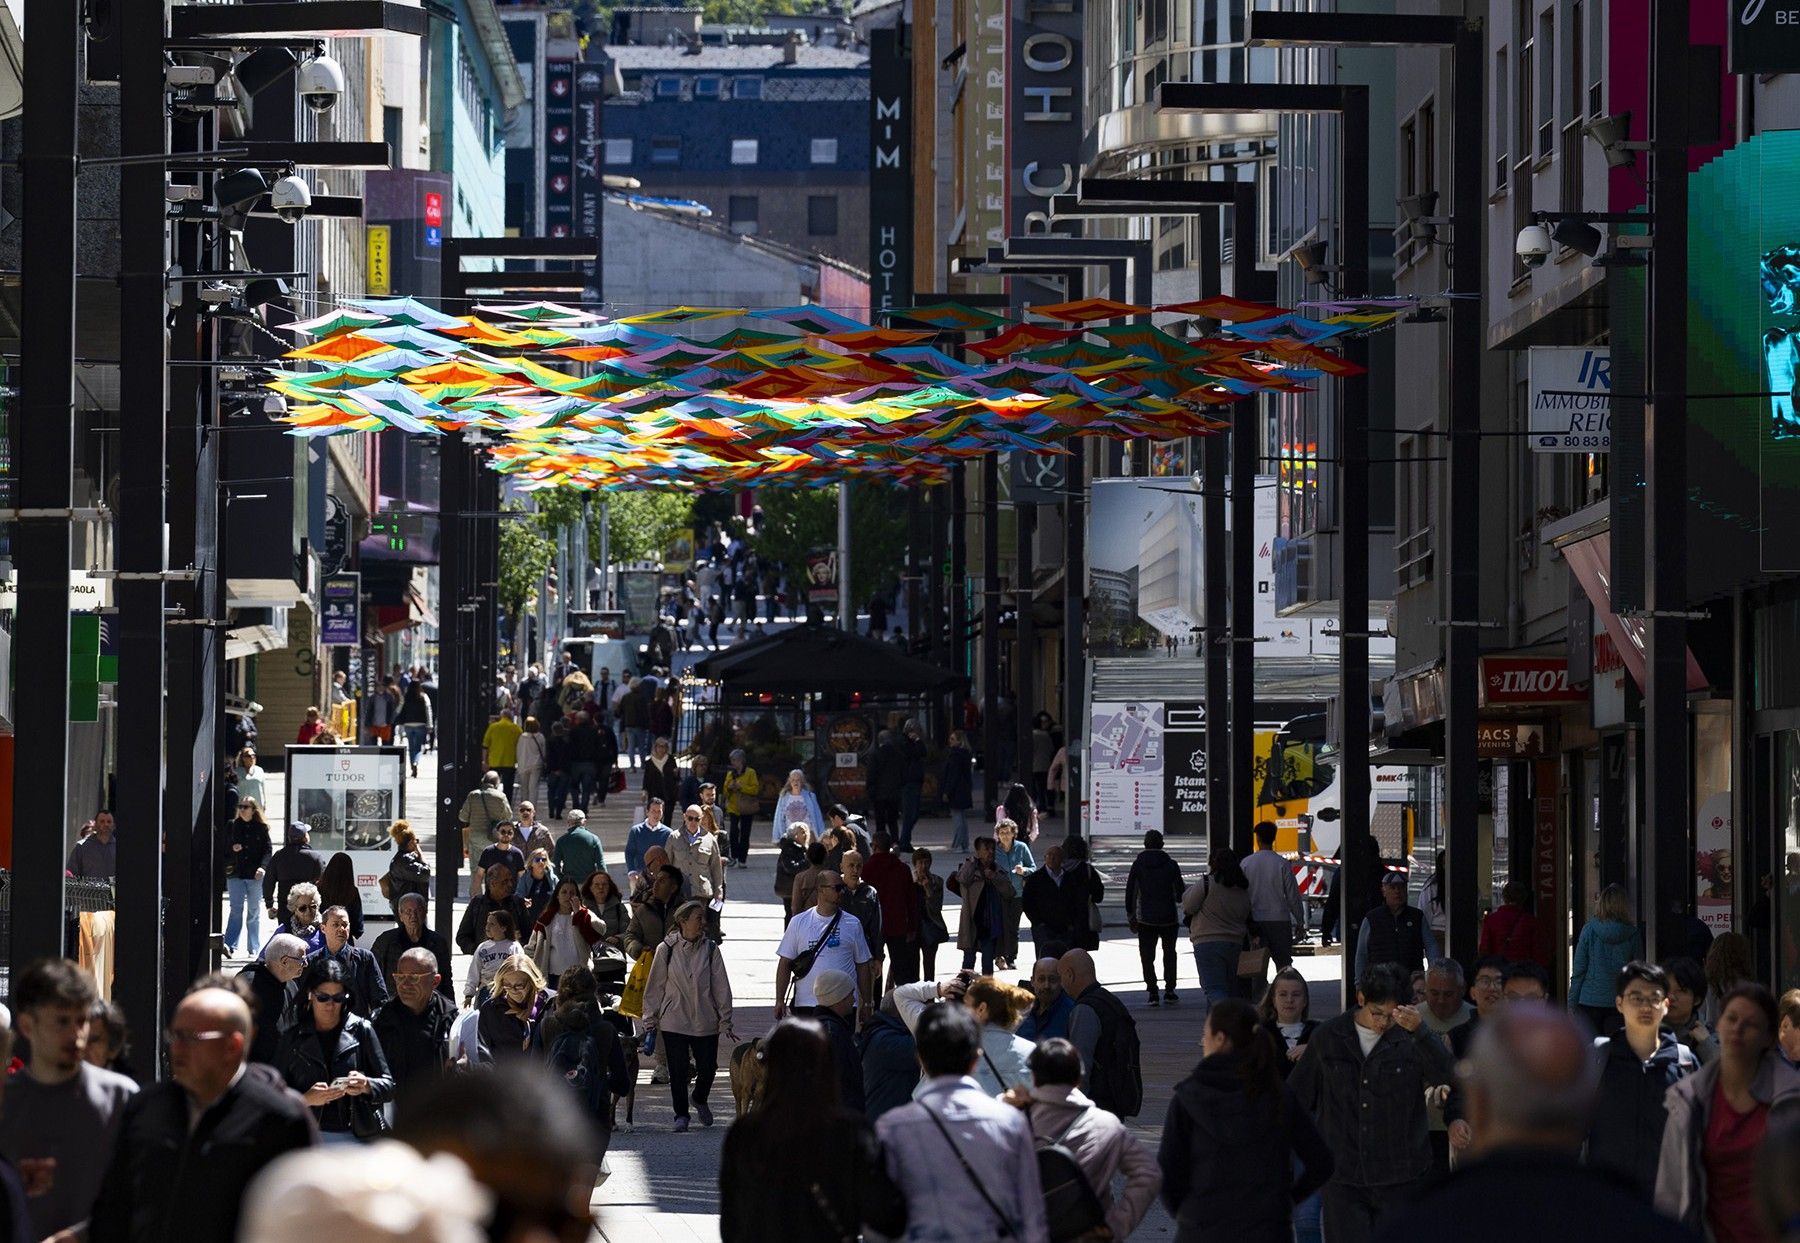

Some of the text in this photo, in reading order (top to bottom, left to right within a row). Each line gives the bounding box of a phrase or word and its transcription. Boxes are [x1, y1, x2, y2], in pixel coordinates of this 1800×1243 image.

[876, 97, 901, 169] MIM
[1564, 436, 1580, 447] 80
[1583, 436, 1599, 447] 83
[326, 773, 365, 782] TUDOR
